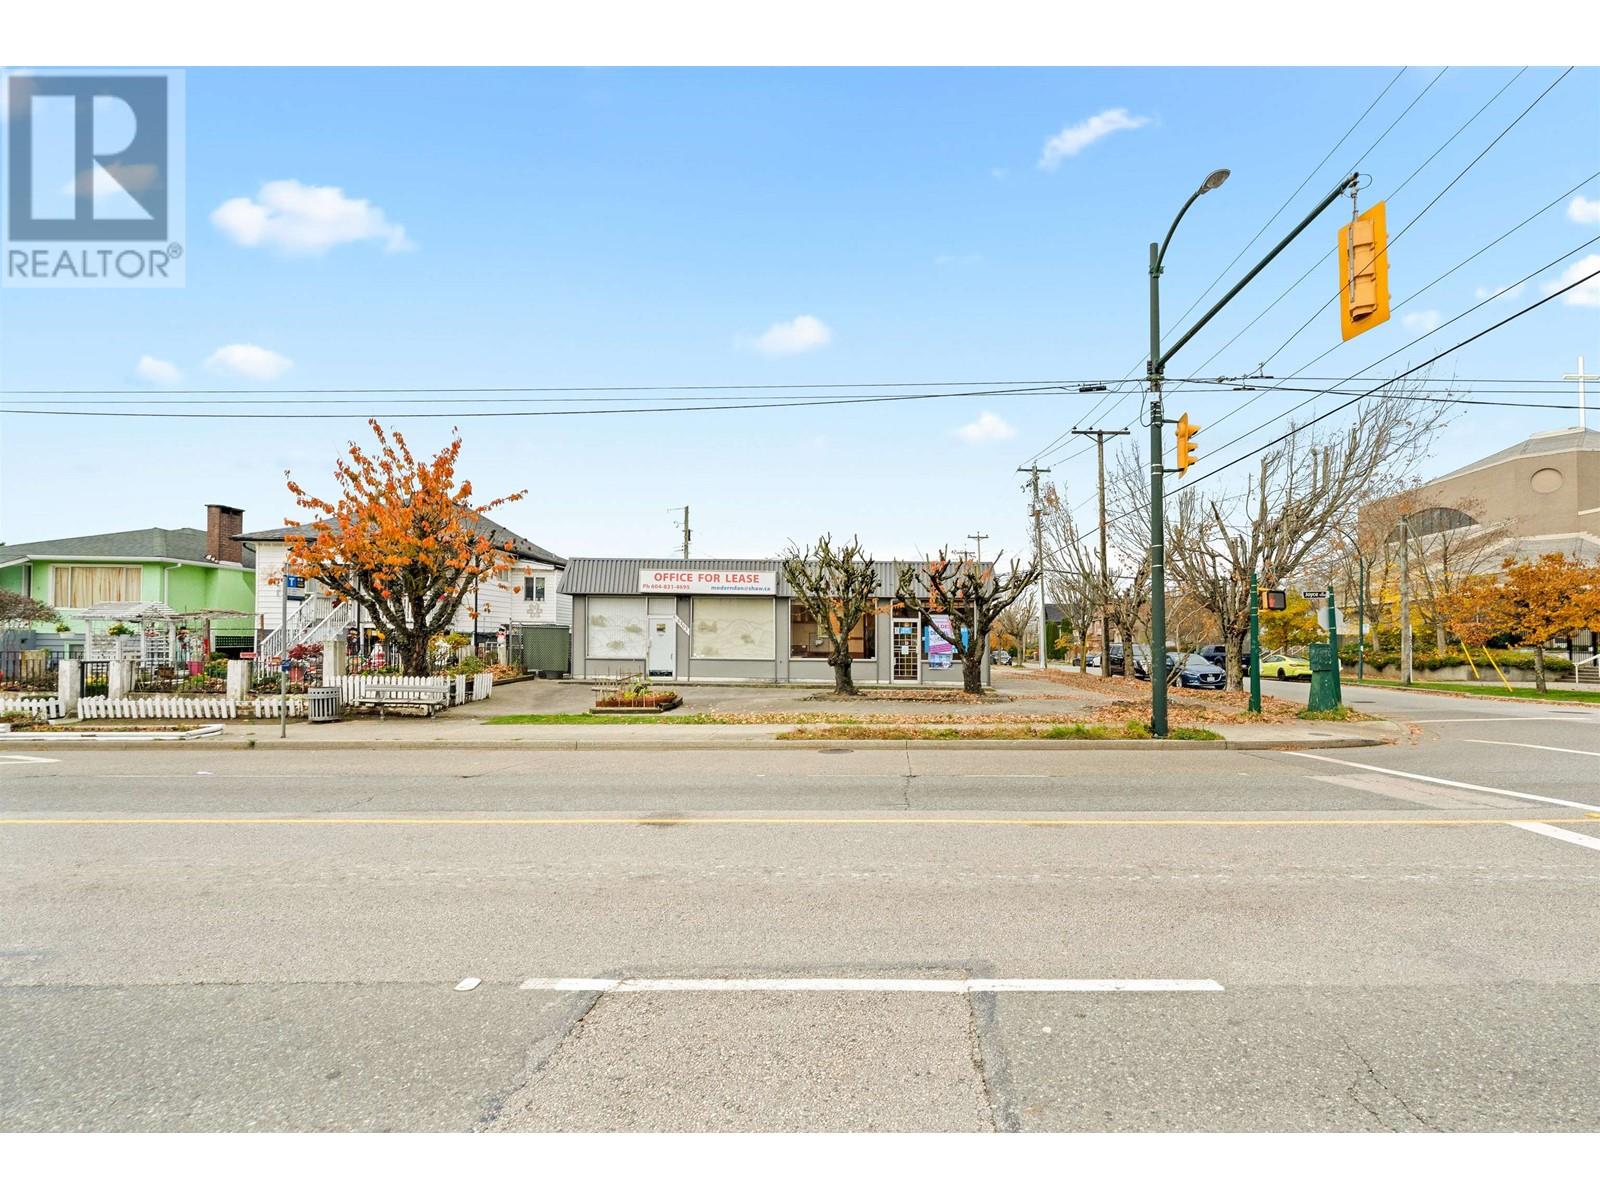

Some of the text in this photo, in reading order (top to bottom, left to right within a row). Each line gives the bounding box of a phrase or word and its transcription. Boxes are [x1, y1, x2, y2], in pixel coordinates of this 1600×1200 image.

[654, 572, 760, 583] OFFICE FOR LEASE
